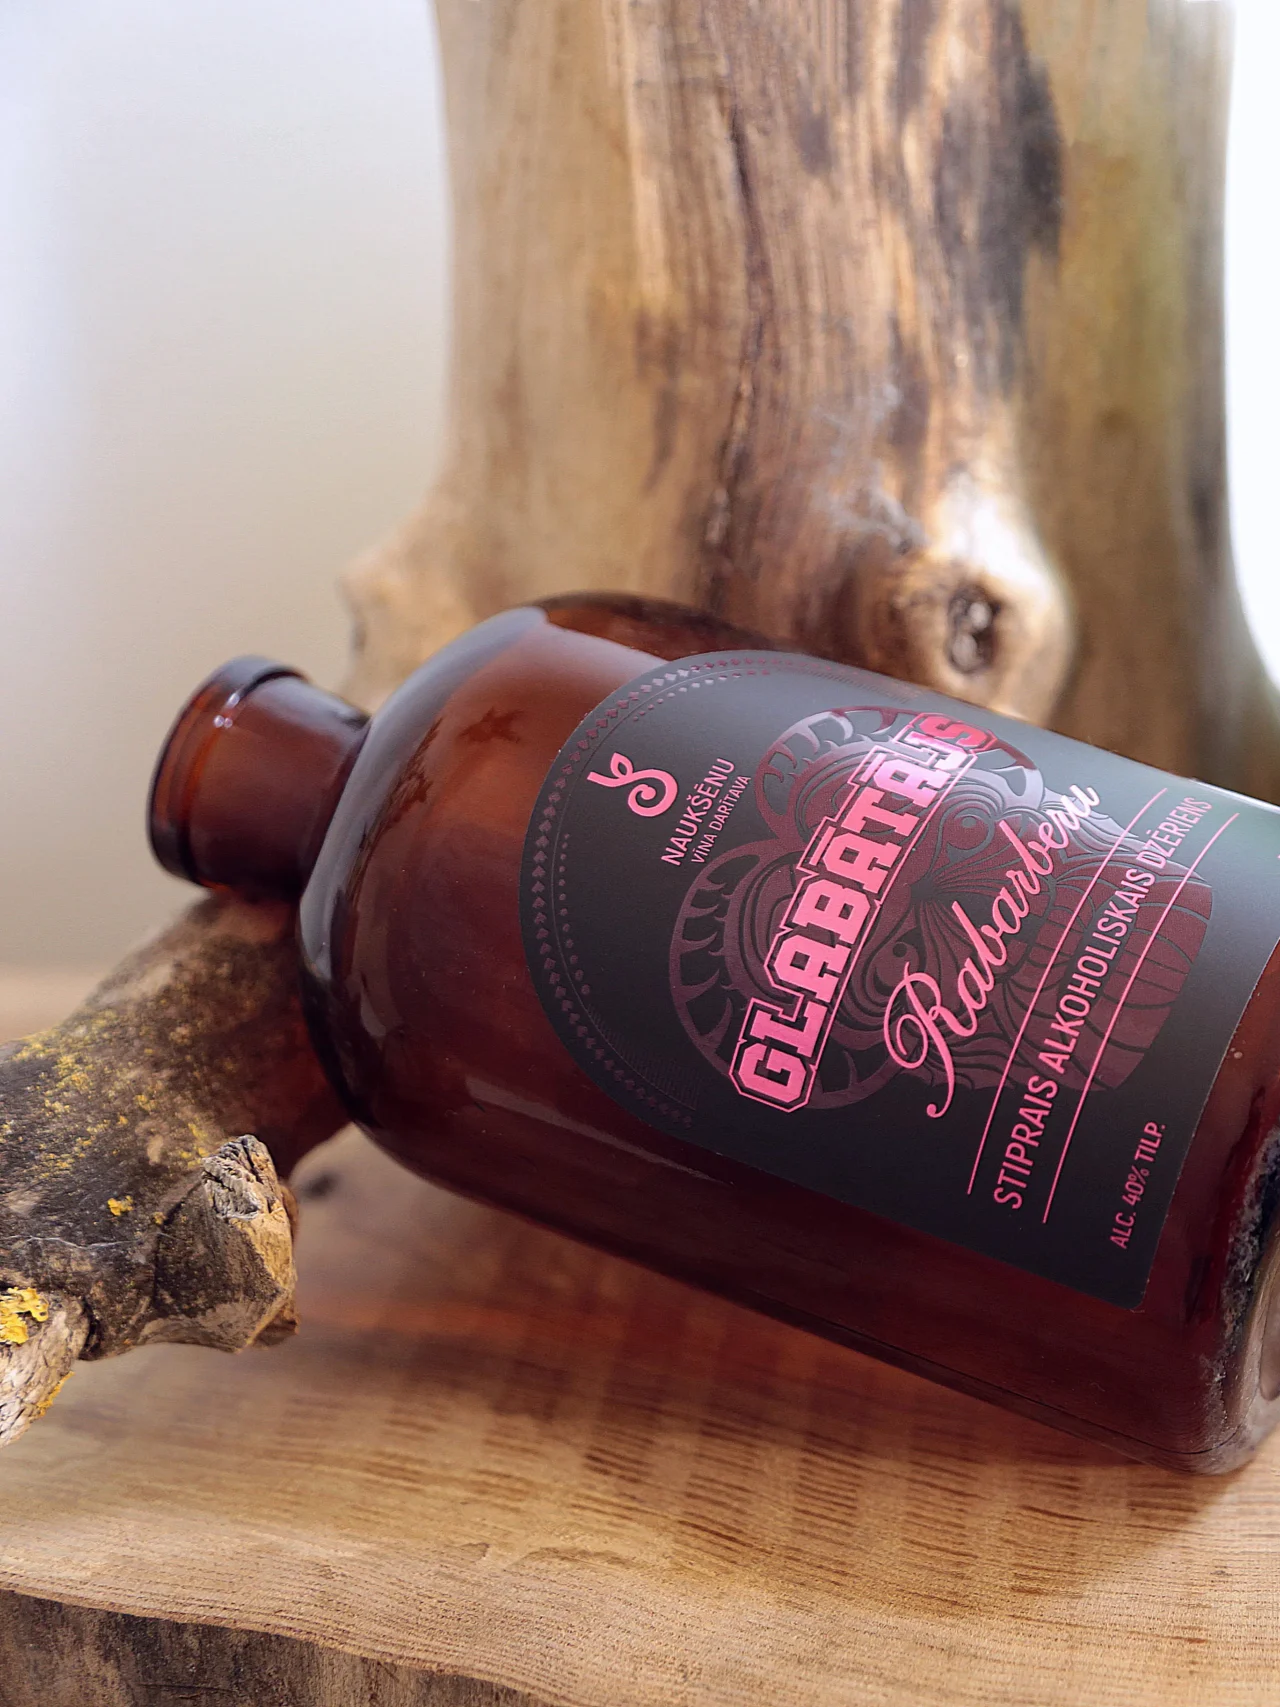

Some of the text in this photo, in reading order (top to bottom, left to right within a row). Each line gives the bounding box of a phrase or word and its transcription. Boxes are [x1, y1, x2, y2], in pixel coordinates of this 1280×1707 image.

[661, 757, 735, 866] NAUKŠĒNU
[690, 775, 752, 864] VĪNA DARĪTAVA
[730, 712, 997, 1112] GLABĀTĀJS
[883, 784, 1100, 1119] Rabarberu
[993, 796, 1213, 1210] STIPRAIS ALKOHOLISKAIS DZĒRIENS
[1110, 1121, 1167, 1249] ALC. 40% TILP.
